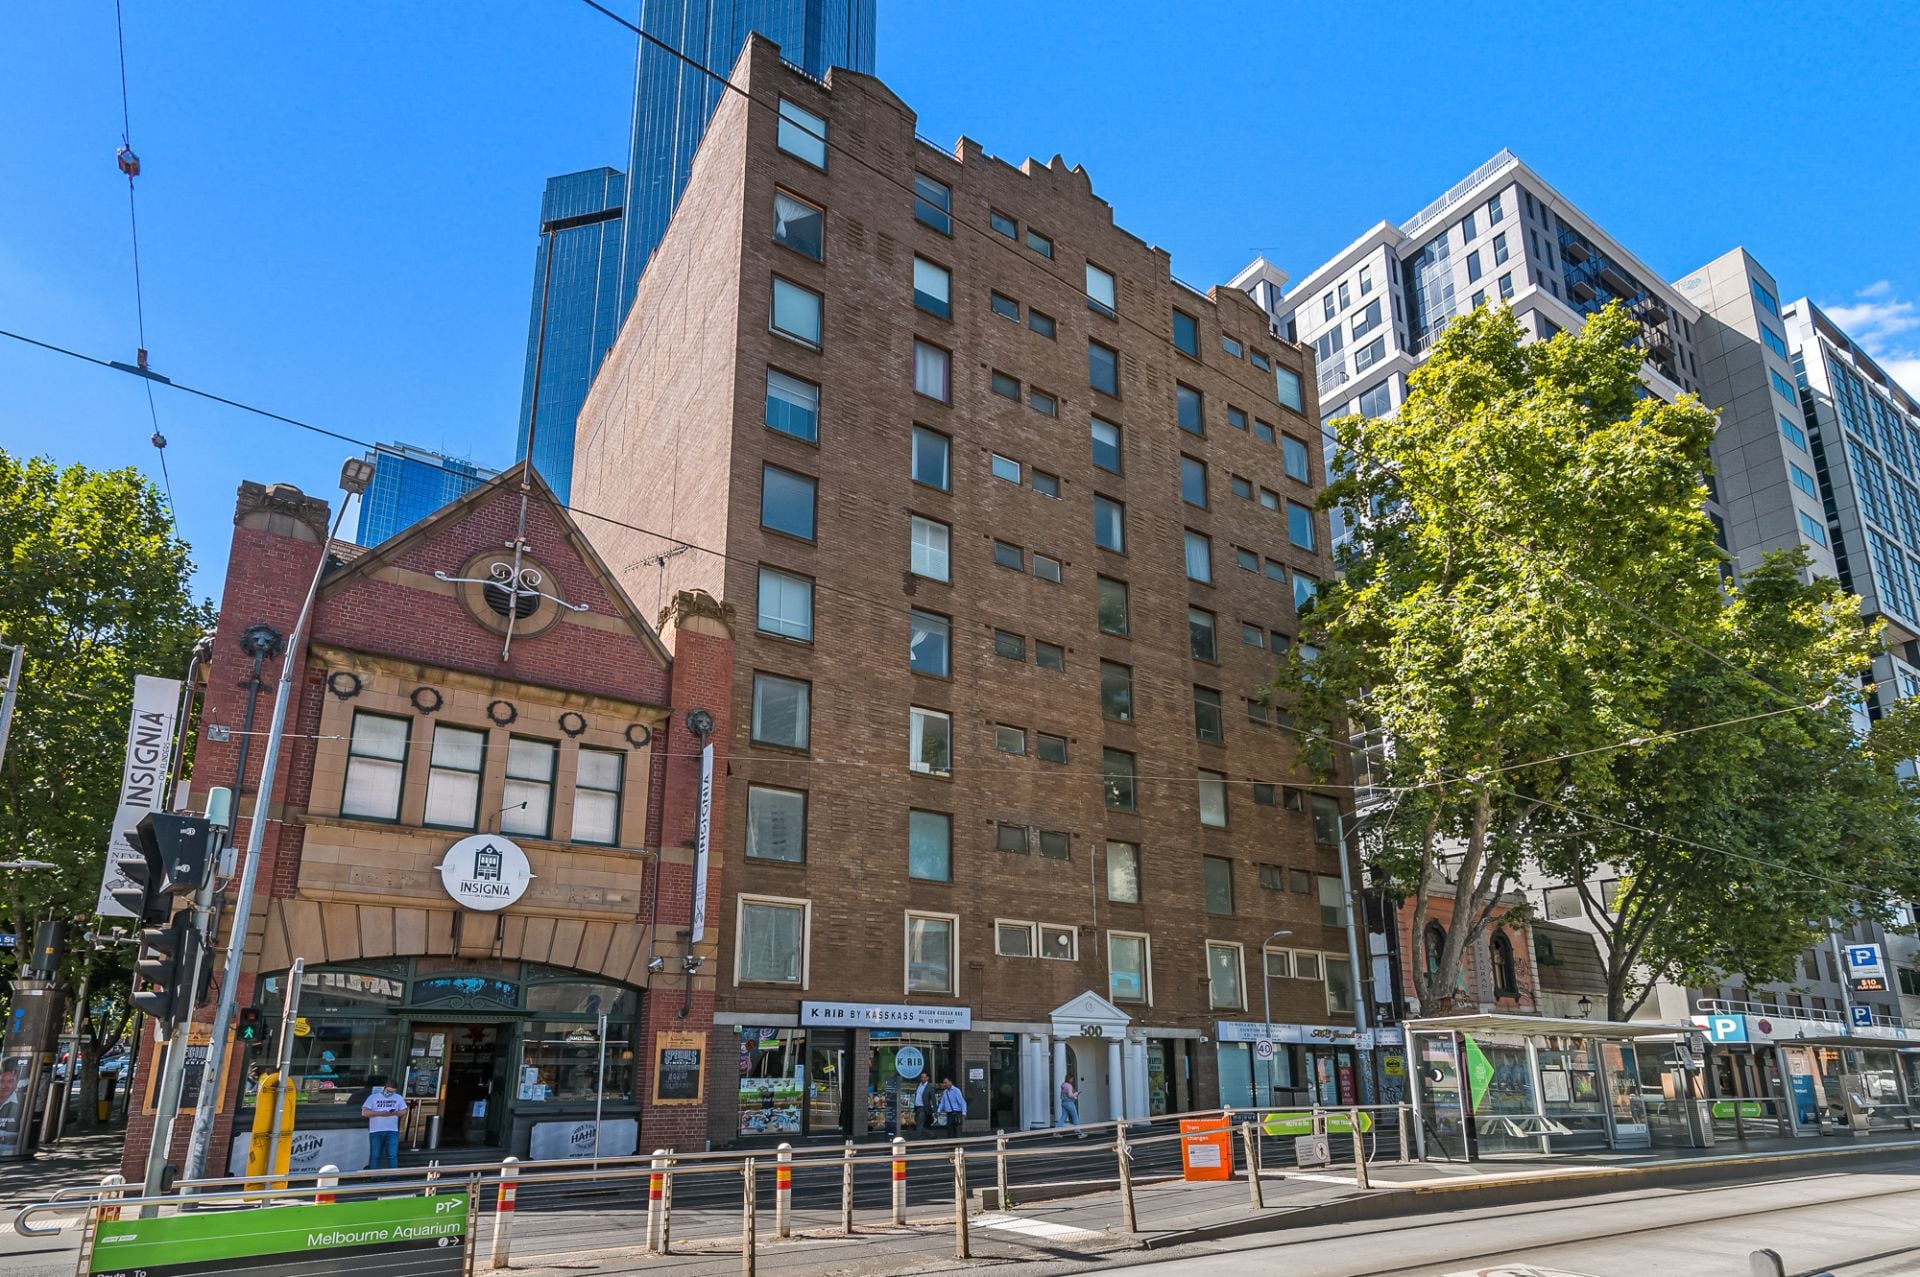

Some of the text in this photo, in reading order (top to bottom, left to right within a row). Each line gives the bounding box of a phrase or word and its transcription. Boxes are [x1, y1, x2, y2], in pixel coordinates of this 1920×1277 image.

[125, 713, 164, 808] INSIGNIA
[460, 881, 511, 896] INSIGNIA
[1855, 950, 1871, 964] P
[1477, 941, 1488, 997] ESTAURANT
[850, 1009, 861, 1019] BY
[1854, 1008, 1866, 1020] P
[1080, 1024, 1103, 1037] 500
[1714, 1019, 1737, 1040] P
[1259, 1044, 1270, 1052] 40
[307, 1222, 461, 1247] Melbourne Aquarium
